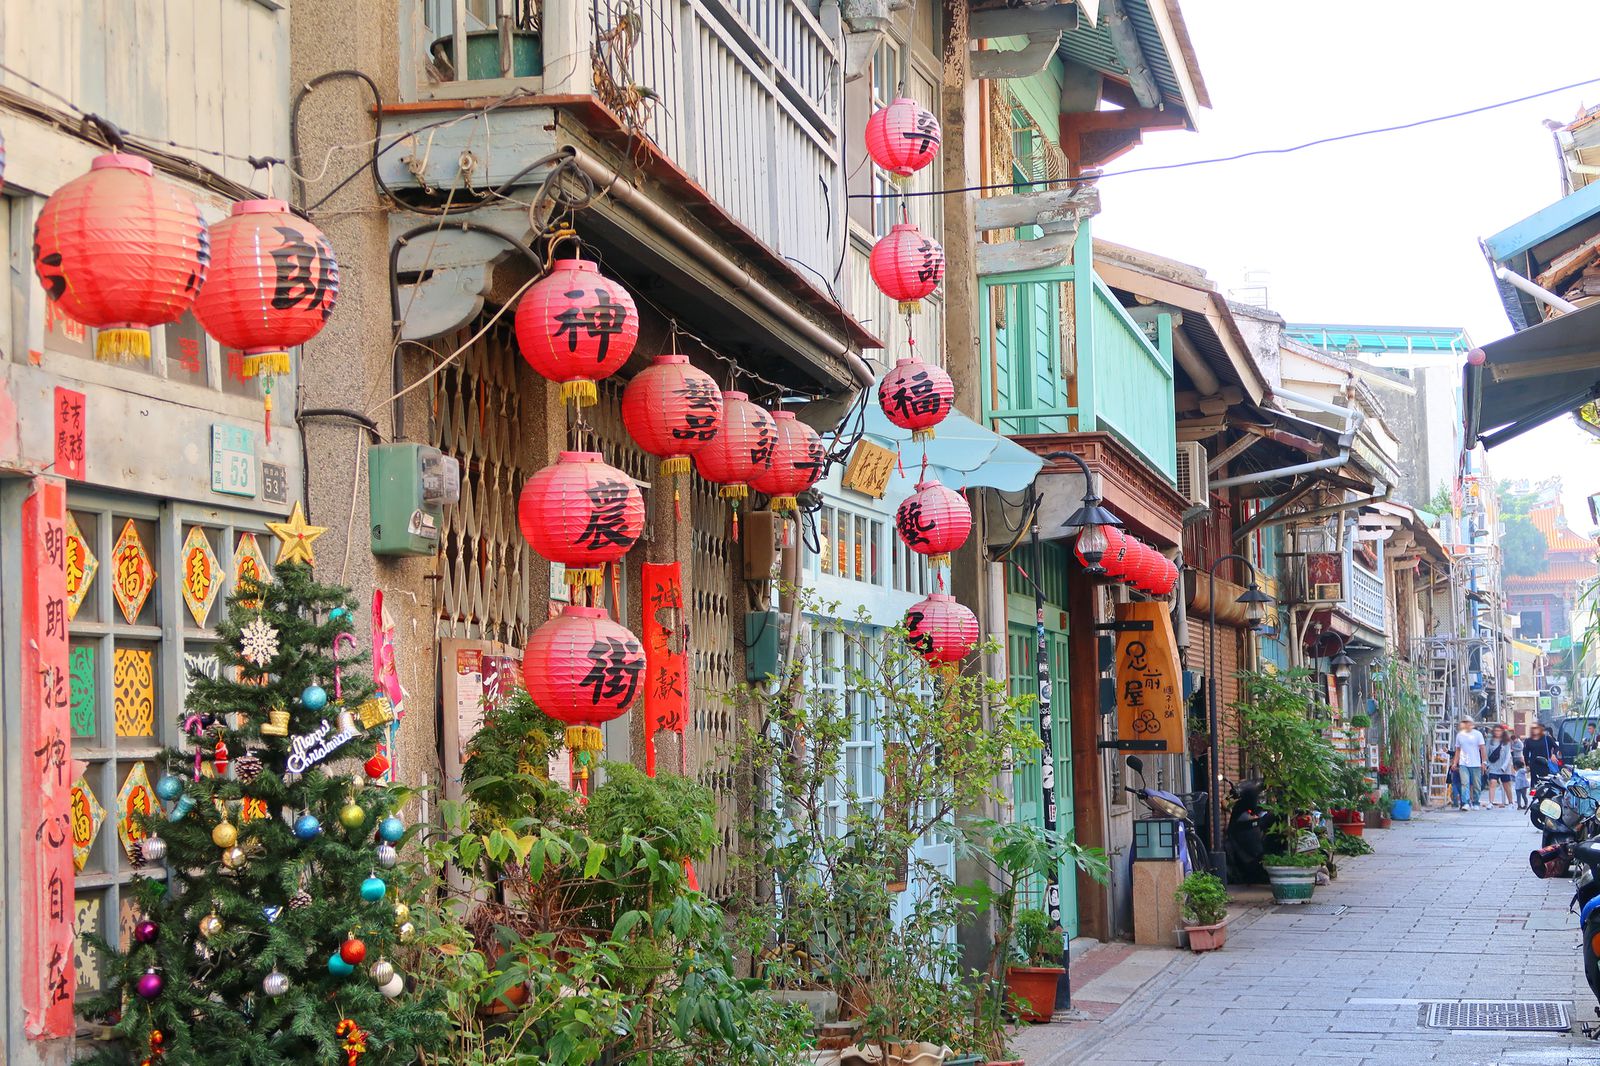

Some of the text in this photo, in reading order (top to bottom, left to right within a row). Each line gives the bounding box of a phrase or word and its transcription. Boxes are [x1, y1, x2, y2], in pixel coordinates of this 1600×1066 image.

[552, 288, 627, 363] 神
[672, 377, 722, 441] 藝品
[892, 371, 941, 419] 福
[230, 456, 248, 487] 53
[265, 478, 279, 495] 53
[573, 477, 639, 551] 農
[897, 501, 936, 544] 藝
[67, 536, 83, 592] 春
[118, 547, 140, 598] 福
[190, 549, 209, 600] 春
[579, 636, 646, 709] 街
[287, 730, 353, 773] Christmas
[290, 719, 331, 757] Merry
[71, 790, 91, 842] 福
